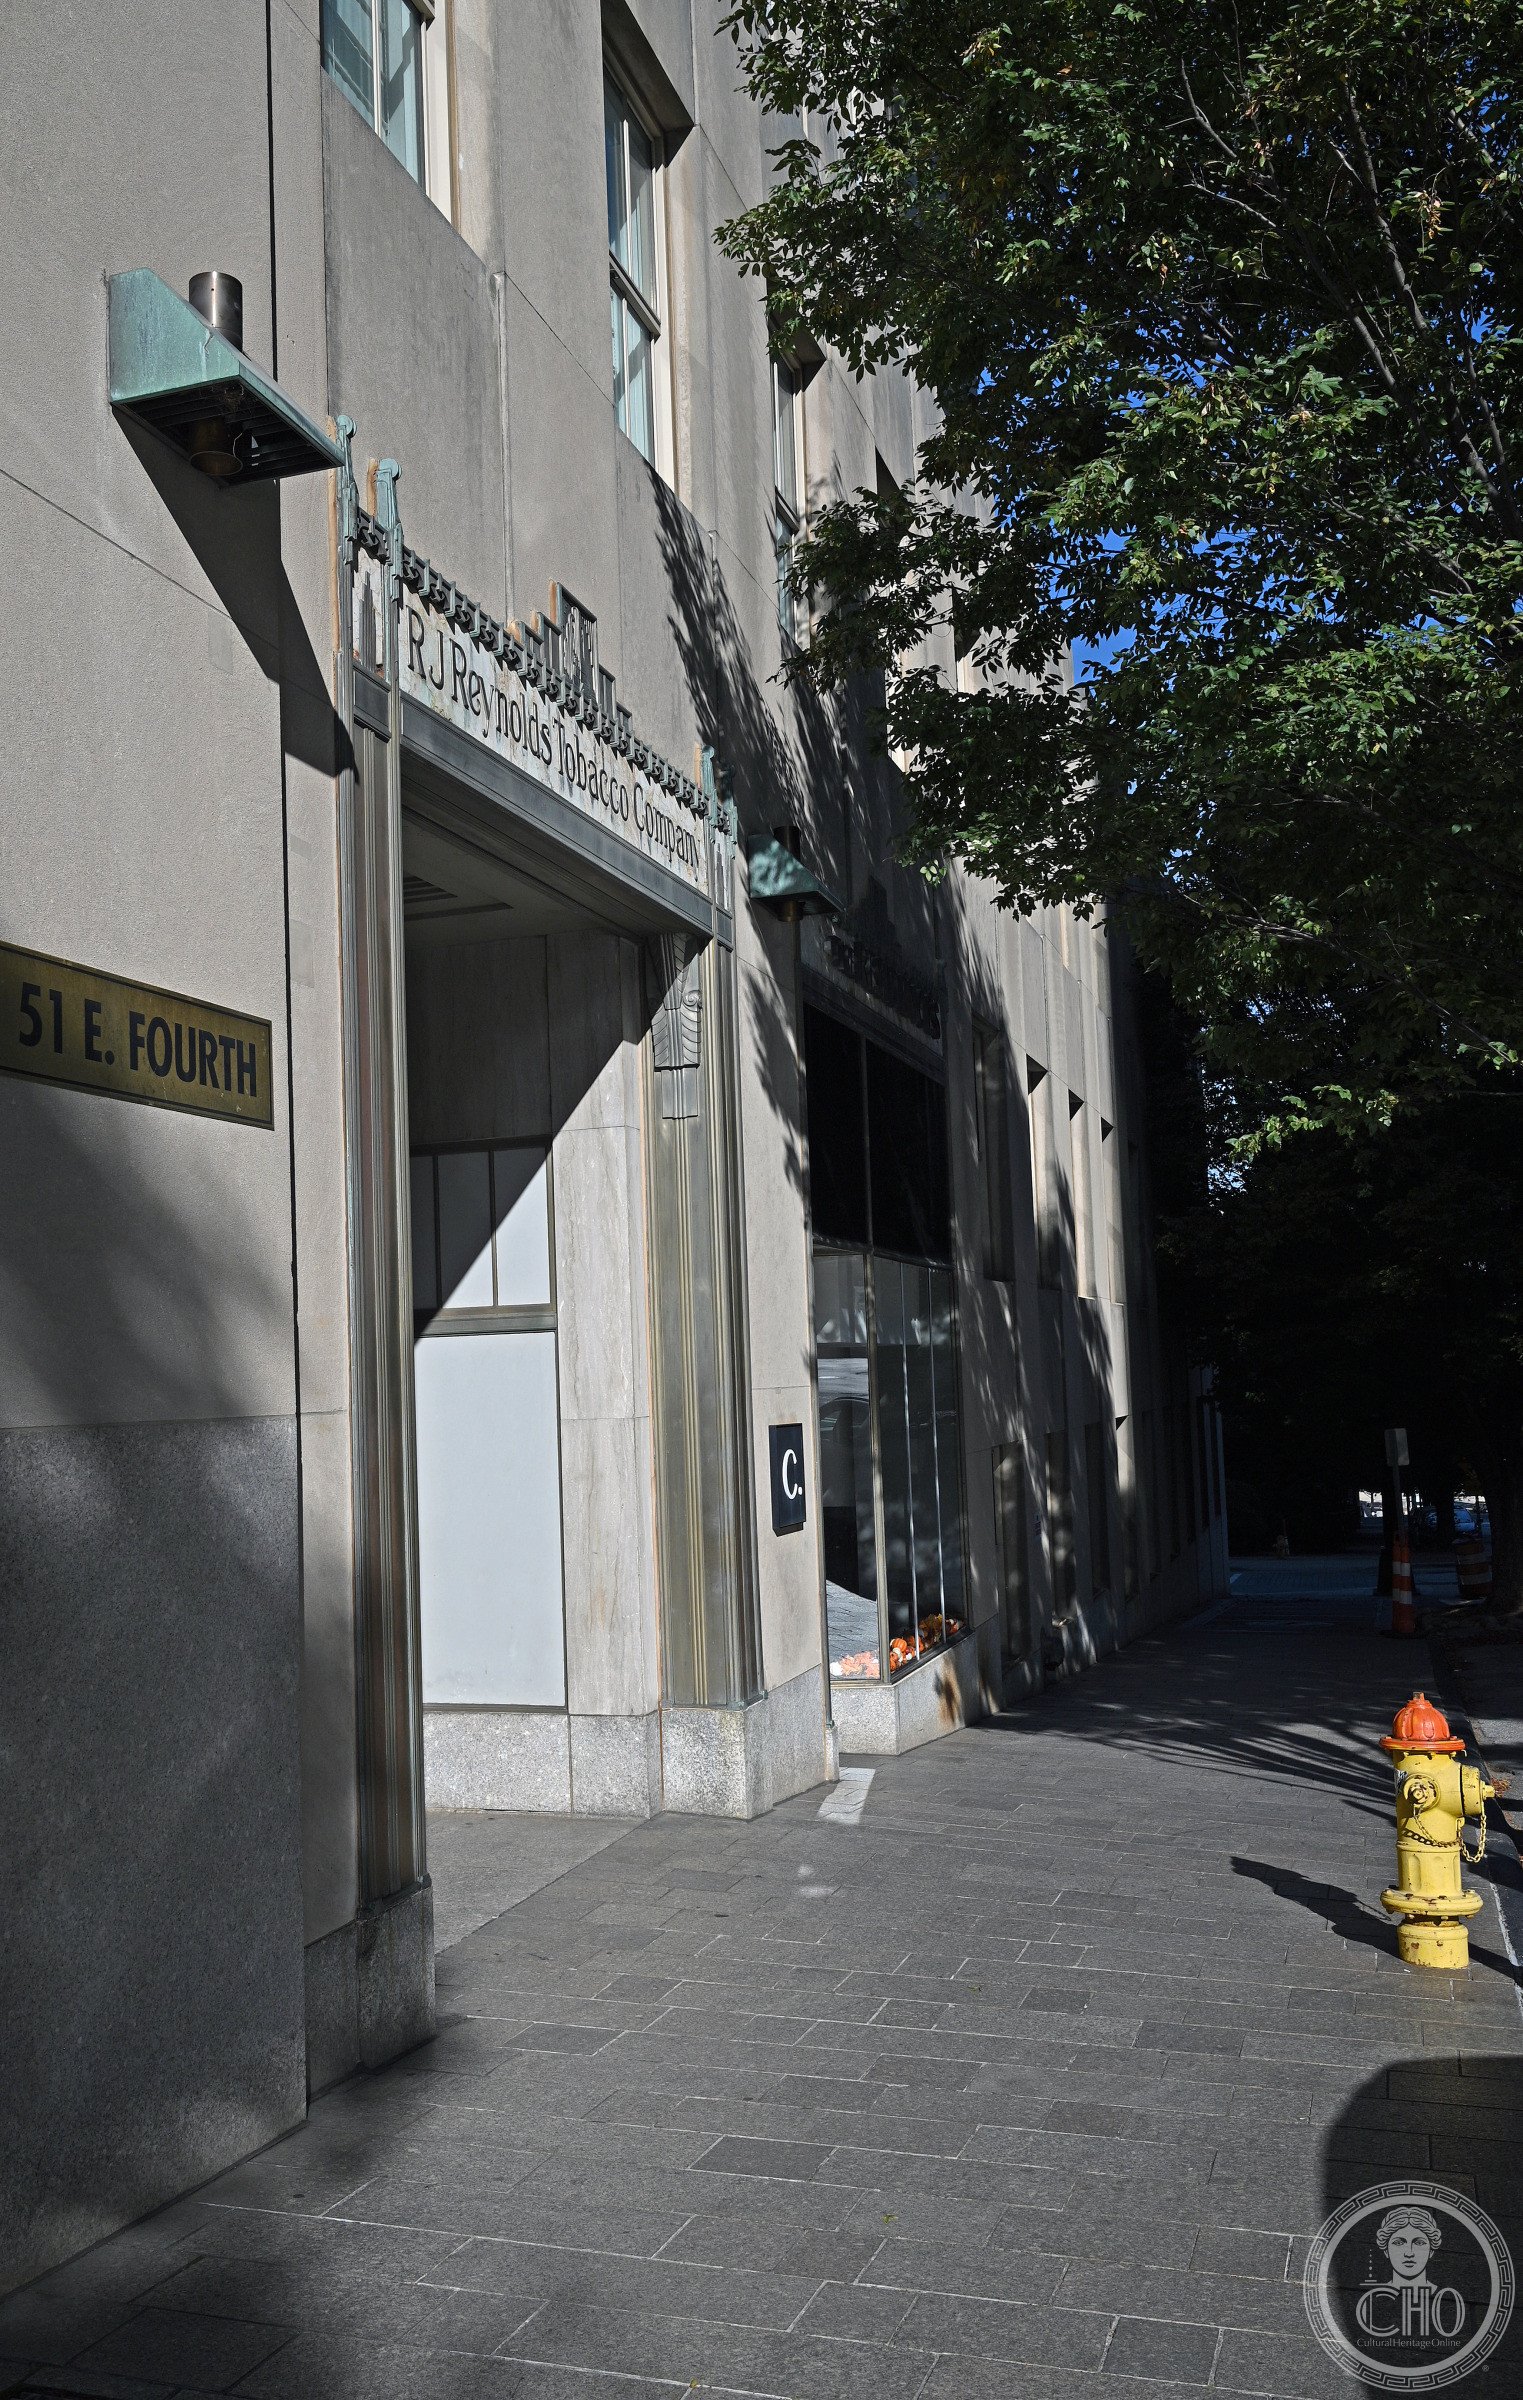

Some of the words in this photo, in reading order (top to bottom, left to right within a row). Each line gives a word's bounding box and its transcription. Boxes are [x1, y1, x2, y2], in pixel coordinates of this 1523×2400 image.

[449, 638, 552, 765] Reynolds
[553, 717, 629, 821] Tobacco
[633, 782, 699, 882] Company
[19, 981, 63, 1055] 51
[84, 998, 115, 1065] E.
[129, 1010, 257, 1097] FOURTH
